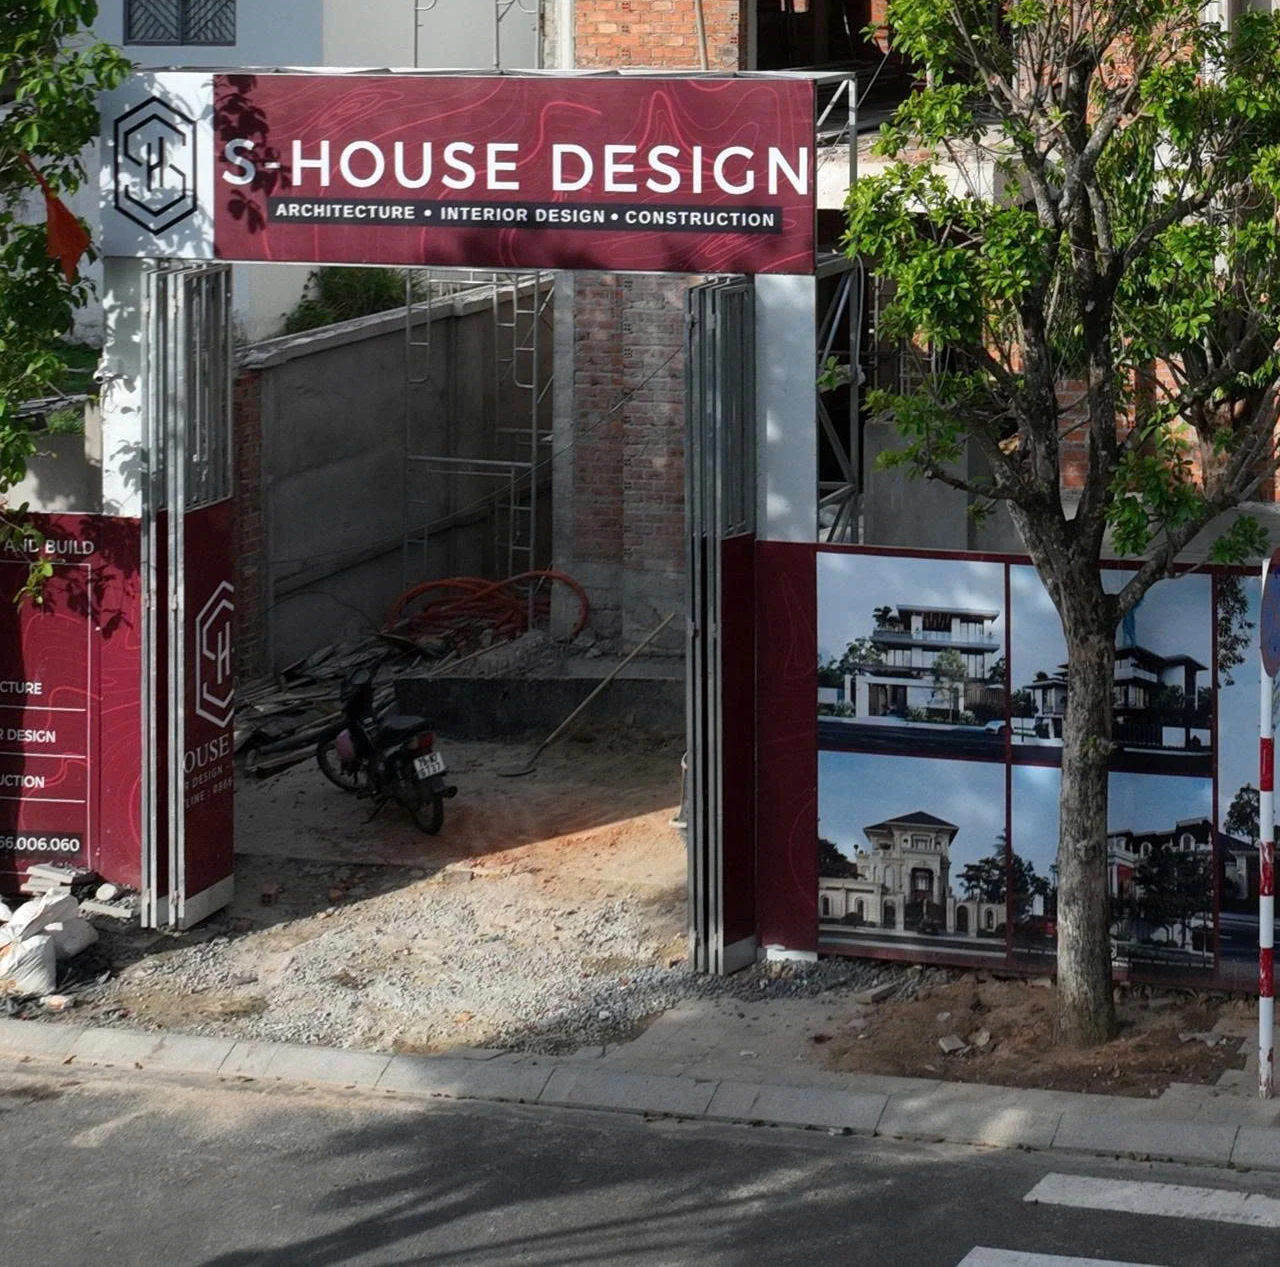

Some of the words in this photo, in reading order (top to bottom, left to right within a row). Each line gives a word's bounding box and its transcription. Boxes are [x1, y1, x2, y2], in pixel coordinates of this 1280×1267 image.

[222, 138, 520, 191] S-HOUSE
[552, 143, 809, 195] DESIGN
[275, 202, 416, 220] ARCHITECTURE
[440, 206, 528, 222] INTERIOR
[535, 208, 605, 224] DESIGN
[625, 210, 775, 227] CONSTRUCTION
[44, 539, 95, 555] BUILD
[6, 728, 56, 744] DESIGN
